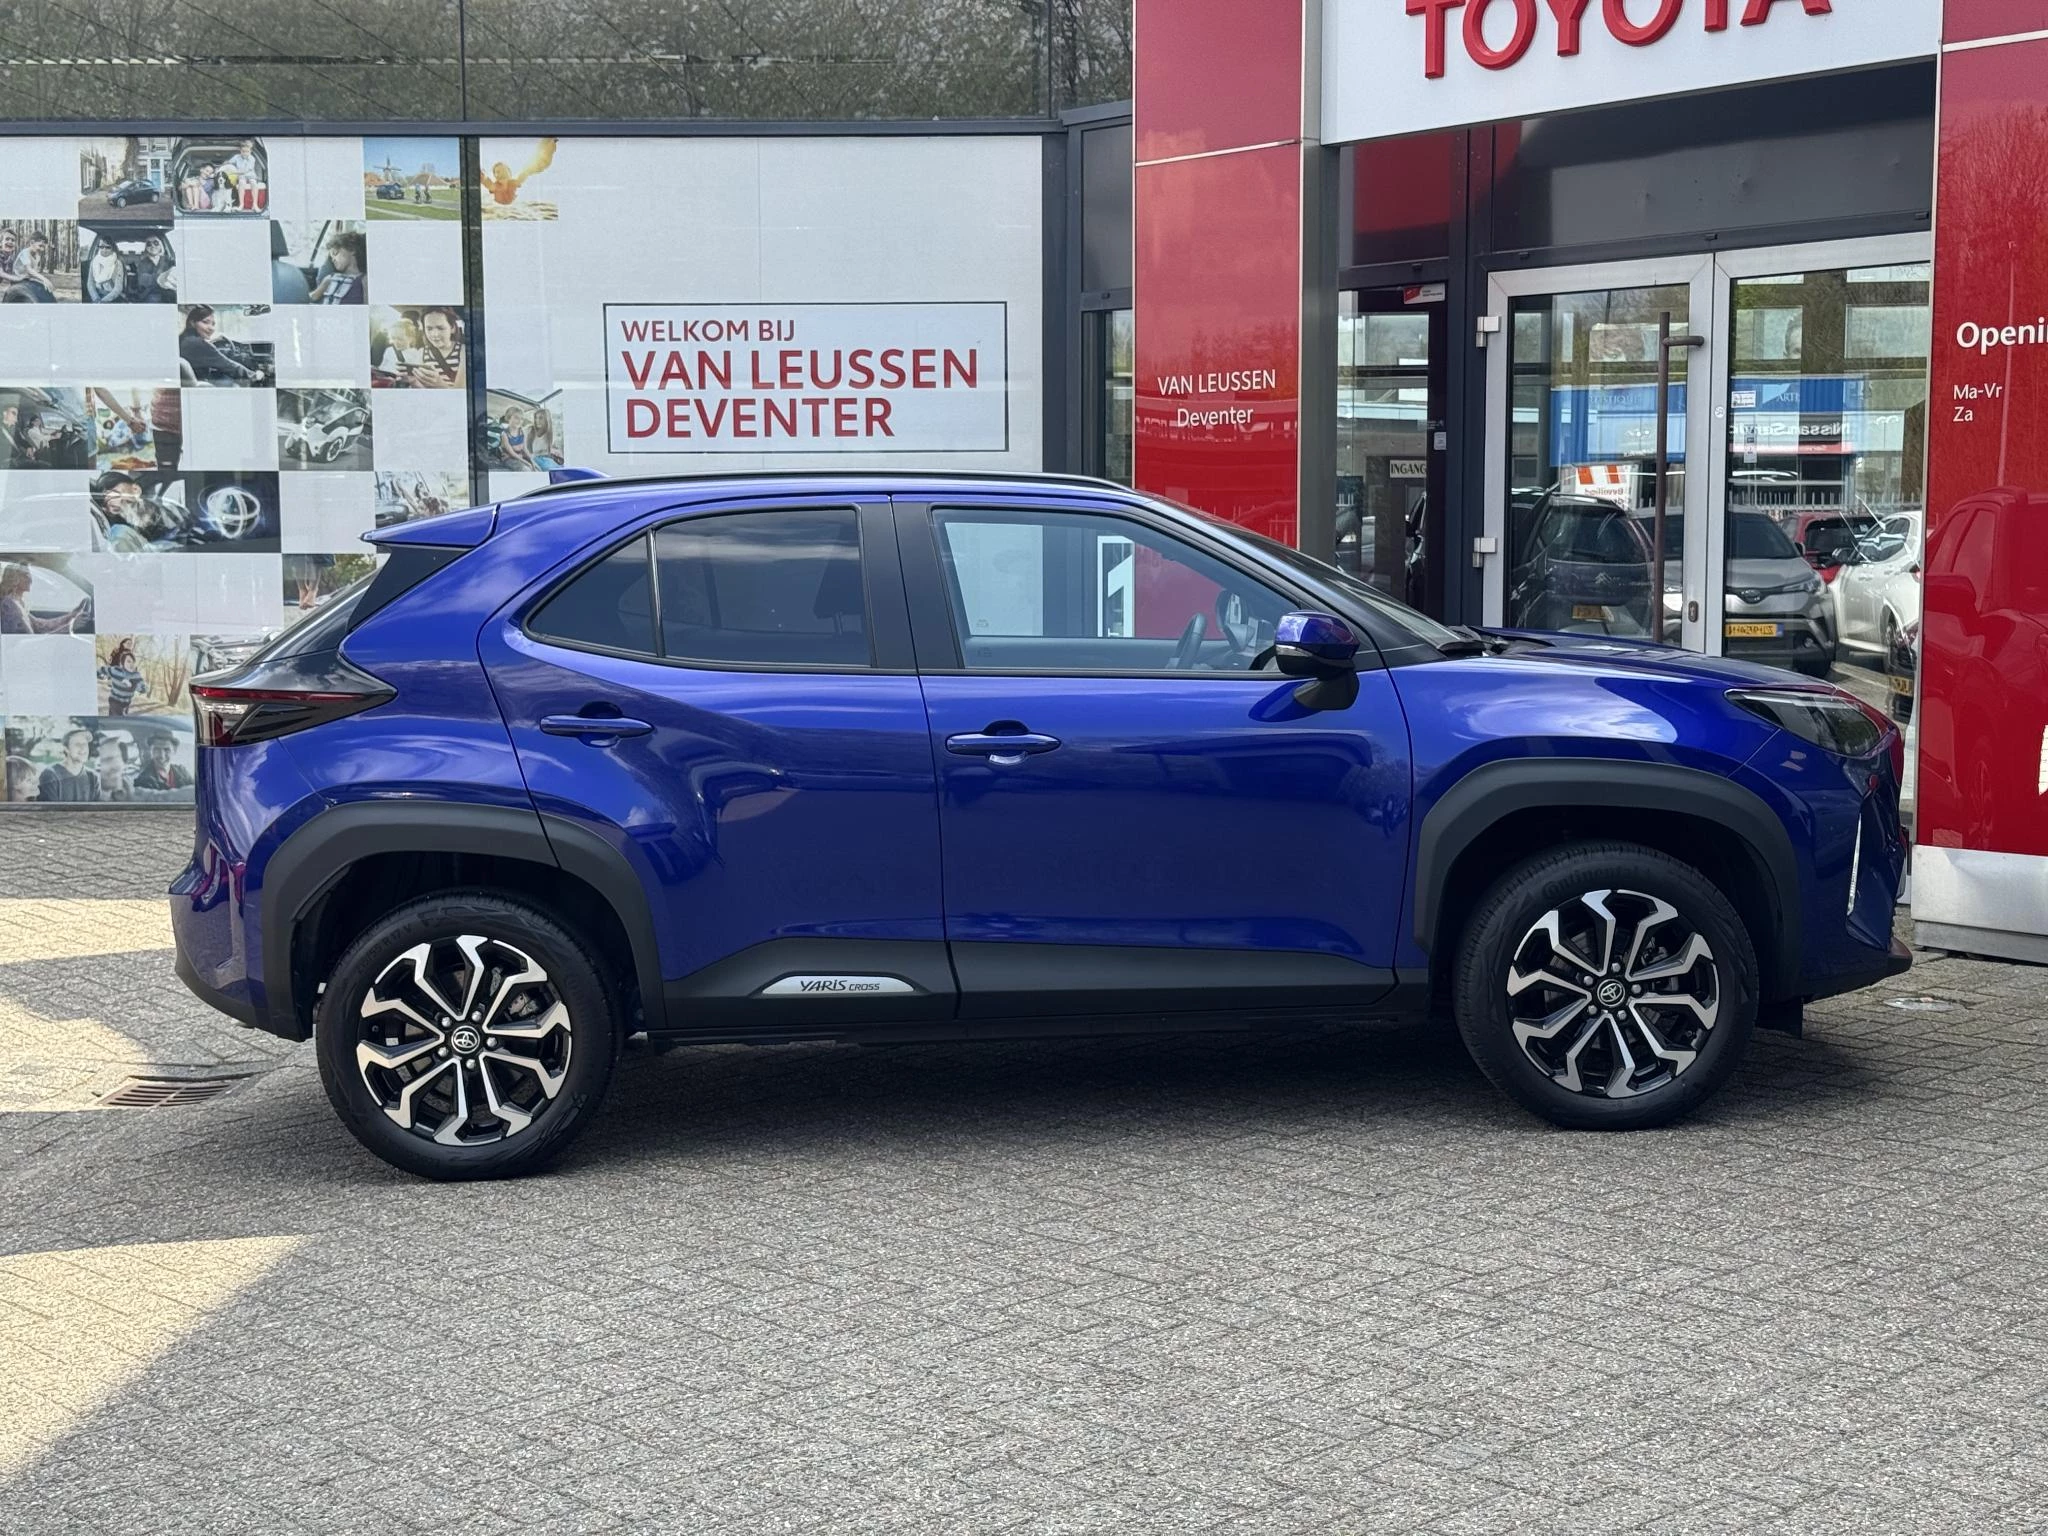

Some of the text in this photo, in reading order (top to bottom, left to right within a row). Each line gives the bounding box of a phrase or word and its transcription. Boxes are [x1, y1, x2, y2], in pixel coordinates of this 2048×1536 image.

[621, 320, 795, 342] WELKOM BIJ
[1956, 316, 2048, 355] Openi
[621, 349, 978, 390] VAN LEUSSEN
[1158, 369, 1276, 395] VAN LEUSSEN
[1953, 383, 2003, 400] Ma-Vr
[626, 397, 895, 438] DEVENTER
[1177, 406, 1254, 427] Deventer
[1953, 406, 1974, 422] Za
[849, 983, 880, 991] CROSS
